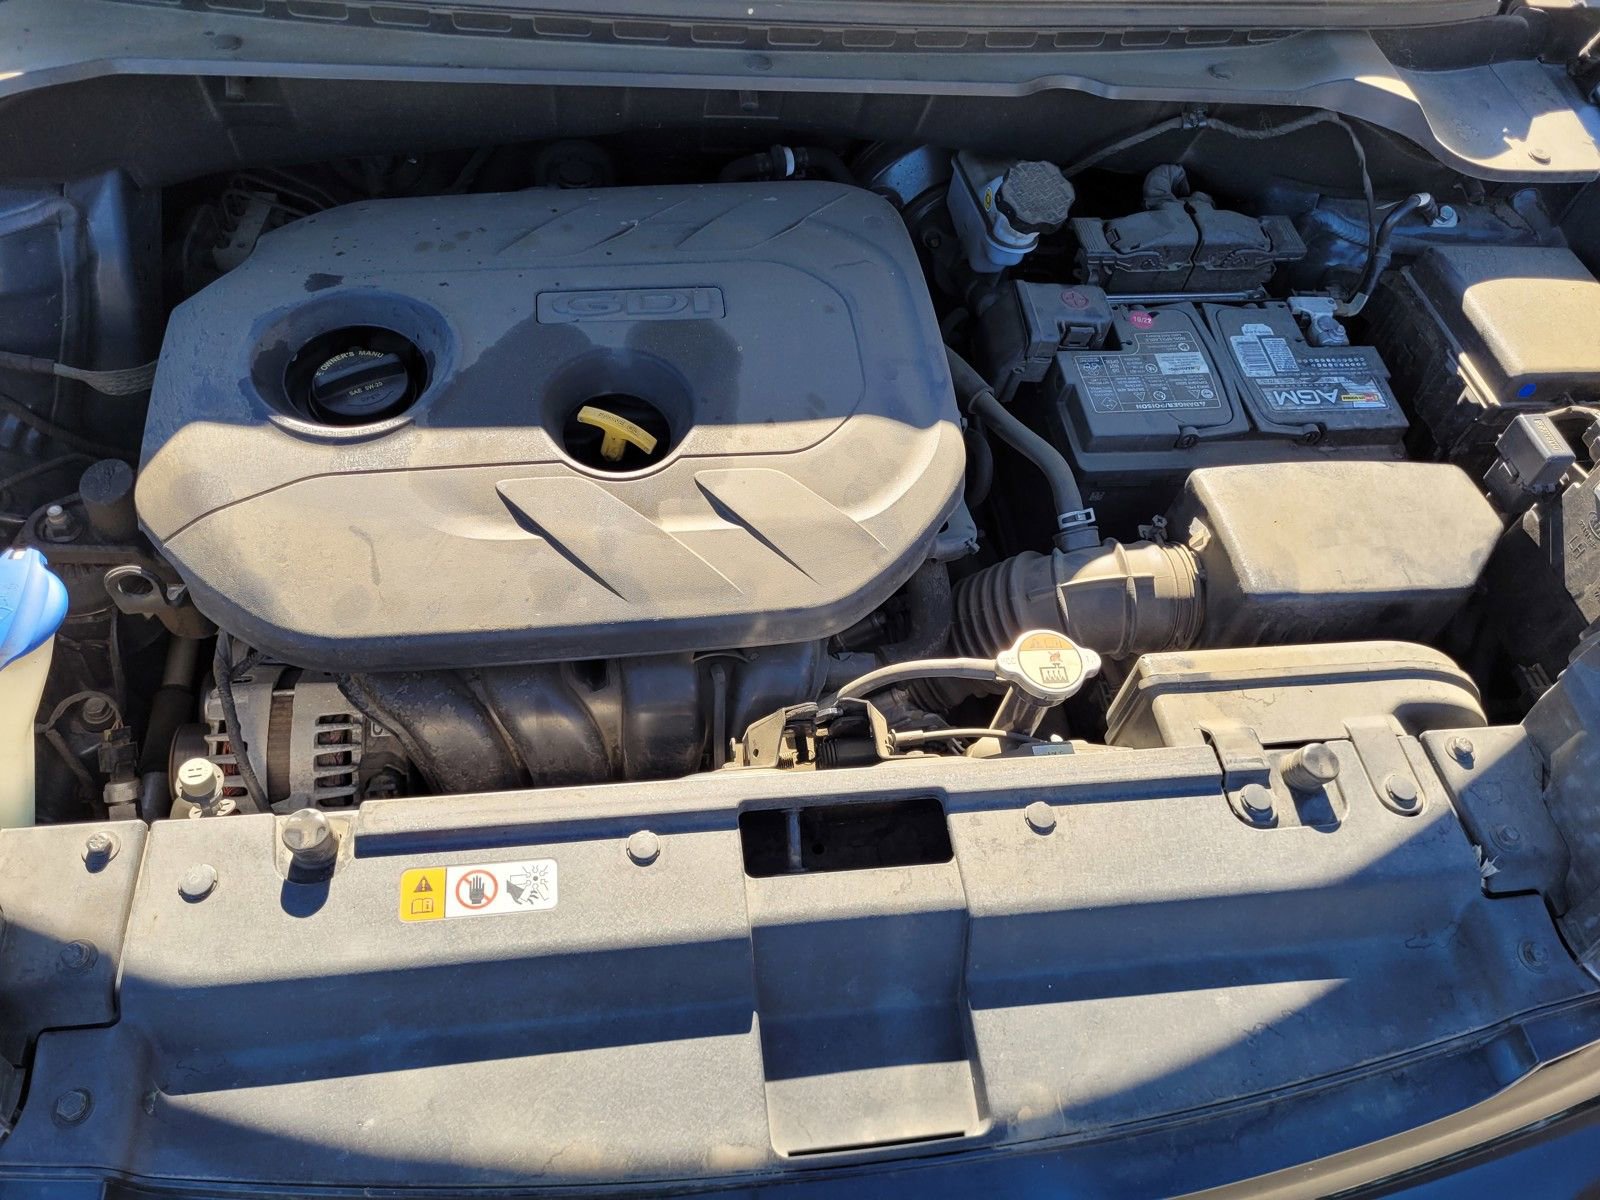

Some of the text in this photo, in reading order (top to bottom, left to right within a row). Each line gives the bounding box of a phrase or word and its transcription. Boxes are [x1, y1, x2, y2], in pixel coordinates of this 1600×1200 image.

[551, 289, 711, 317] GDI
[320, 350, 385, 371] OWNER'S MANU
[1273, 388, 1339, 406] AGM
